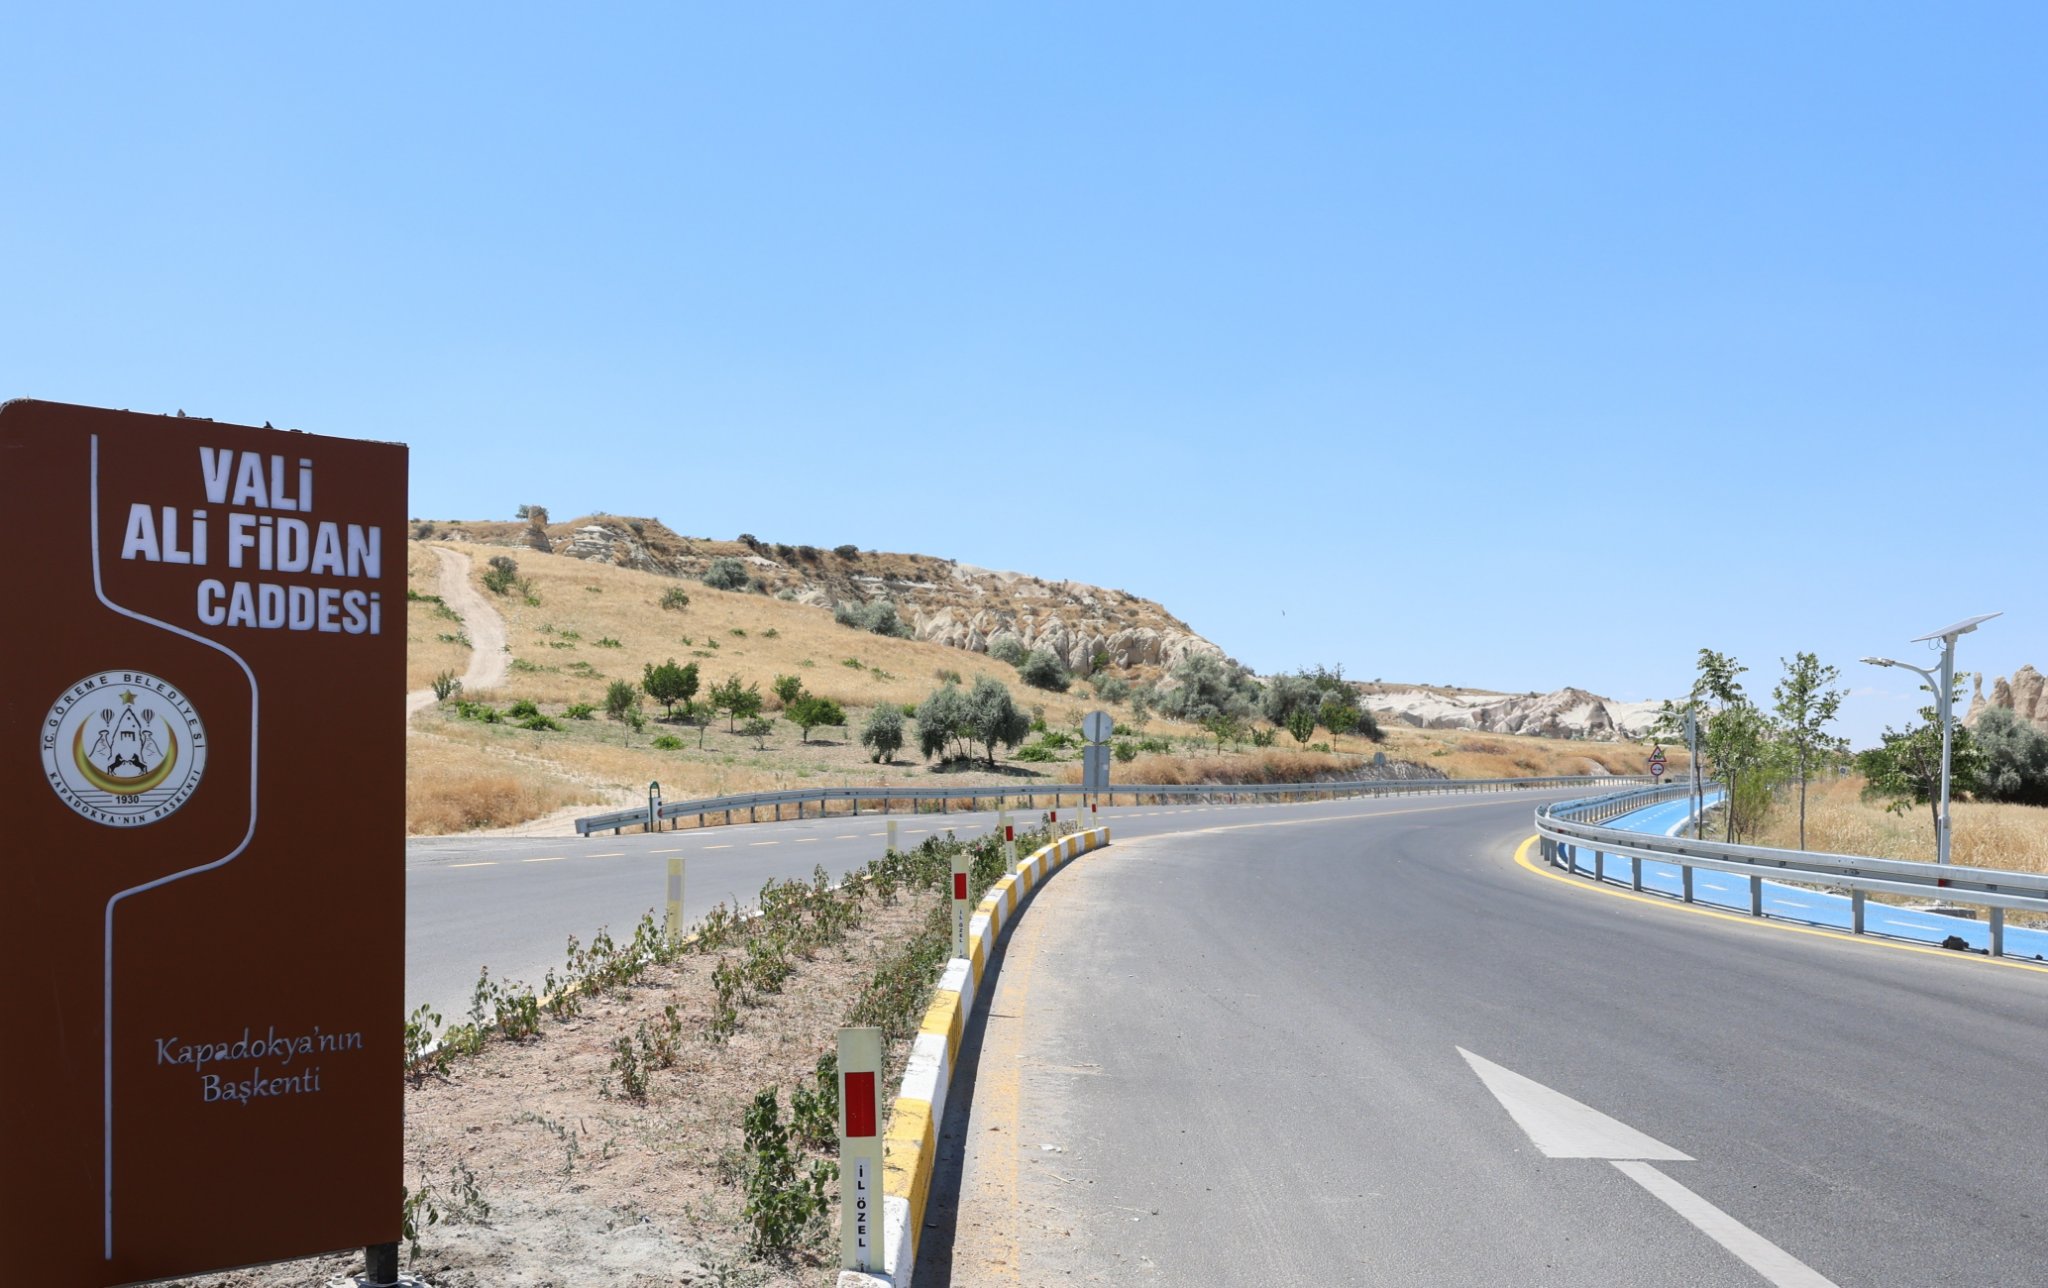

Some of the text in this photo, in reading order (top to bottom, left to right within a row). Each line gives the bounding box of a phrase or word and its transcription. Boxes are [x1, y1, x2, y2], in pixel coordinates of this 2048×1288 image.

[200, 447, 312, 511] VALİ
[122, 504, 381, 578] ALİ FİDAN
[197, 579, 381, 635] CADDESİ
[115, 795, 140, 805] 1930
[201, 1067, 321, 1105] Başkenti
[857, 1165, 866, 1190] İL
[856, 1197, 867, 1248] ÖZEL
